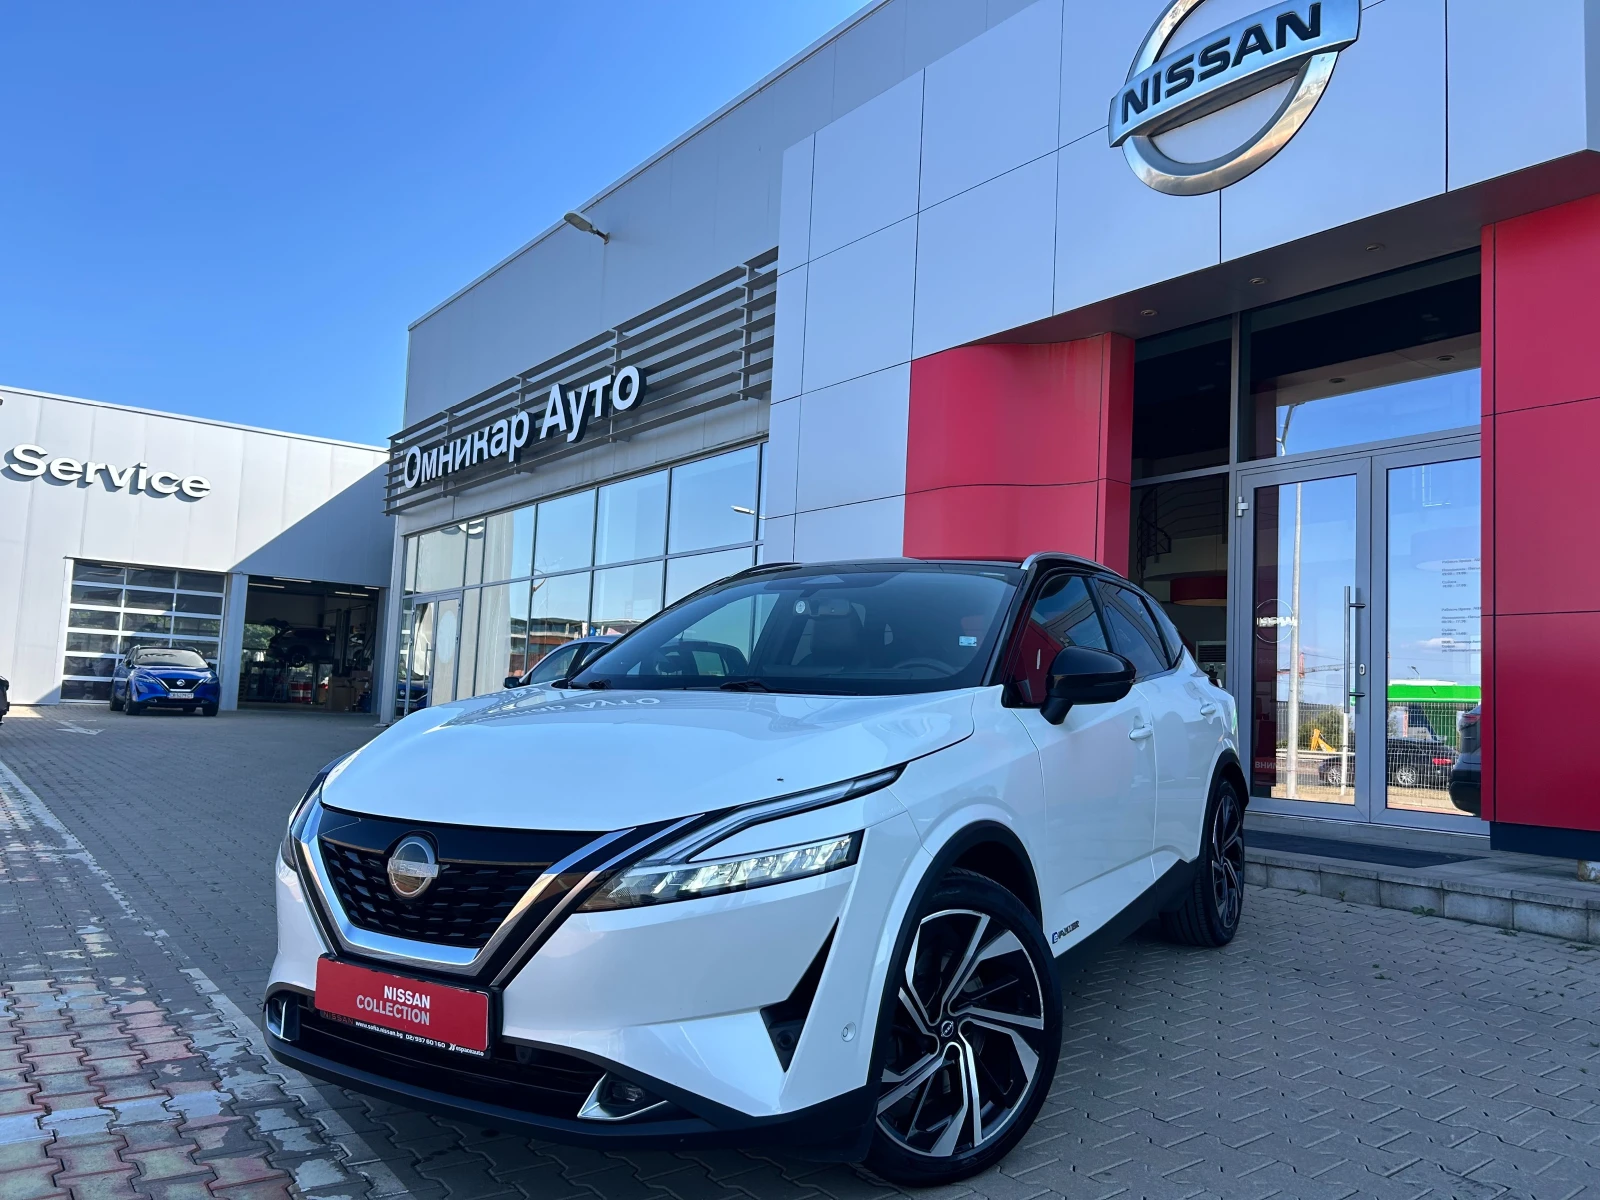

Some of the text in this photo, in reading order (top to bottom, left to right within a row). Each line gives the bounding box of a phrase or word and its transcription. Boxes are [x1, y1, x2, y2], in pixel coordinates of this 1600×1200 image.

[1121, 1, 1321, 125] NISSAN
[404, 365, 644, 489] Омникар Ауто
[9, 443, 212, 499] Service
[323, 1011, 354, 1025] NISSAN
[356, 995, 430, 1025] COLLECTION
[384, 985, 430, 1009] NISSAN
